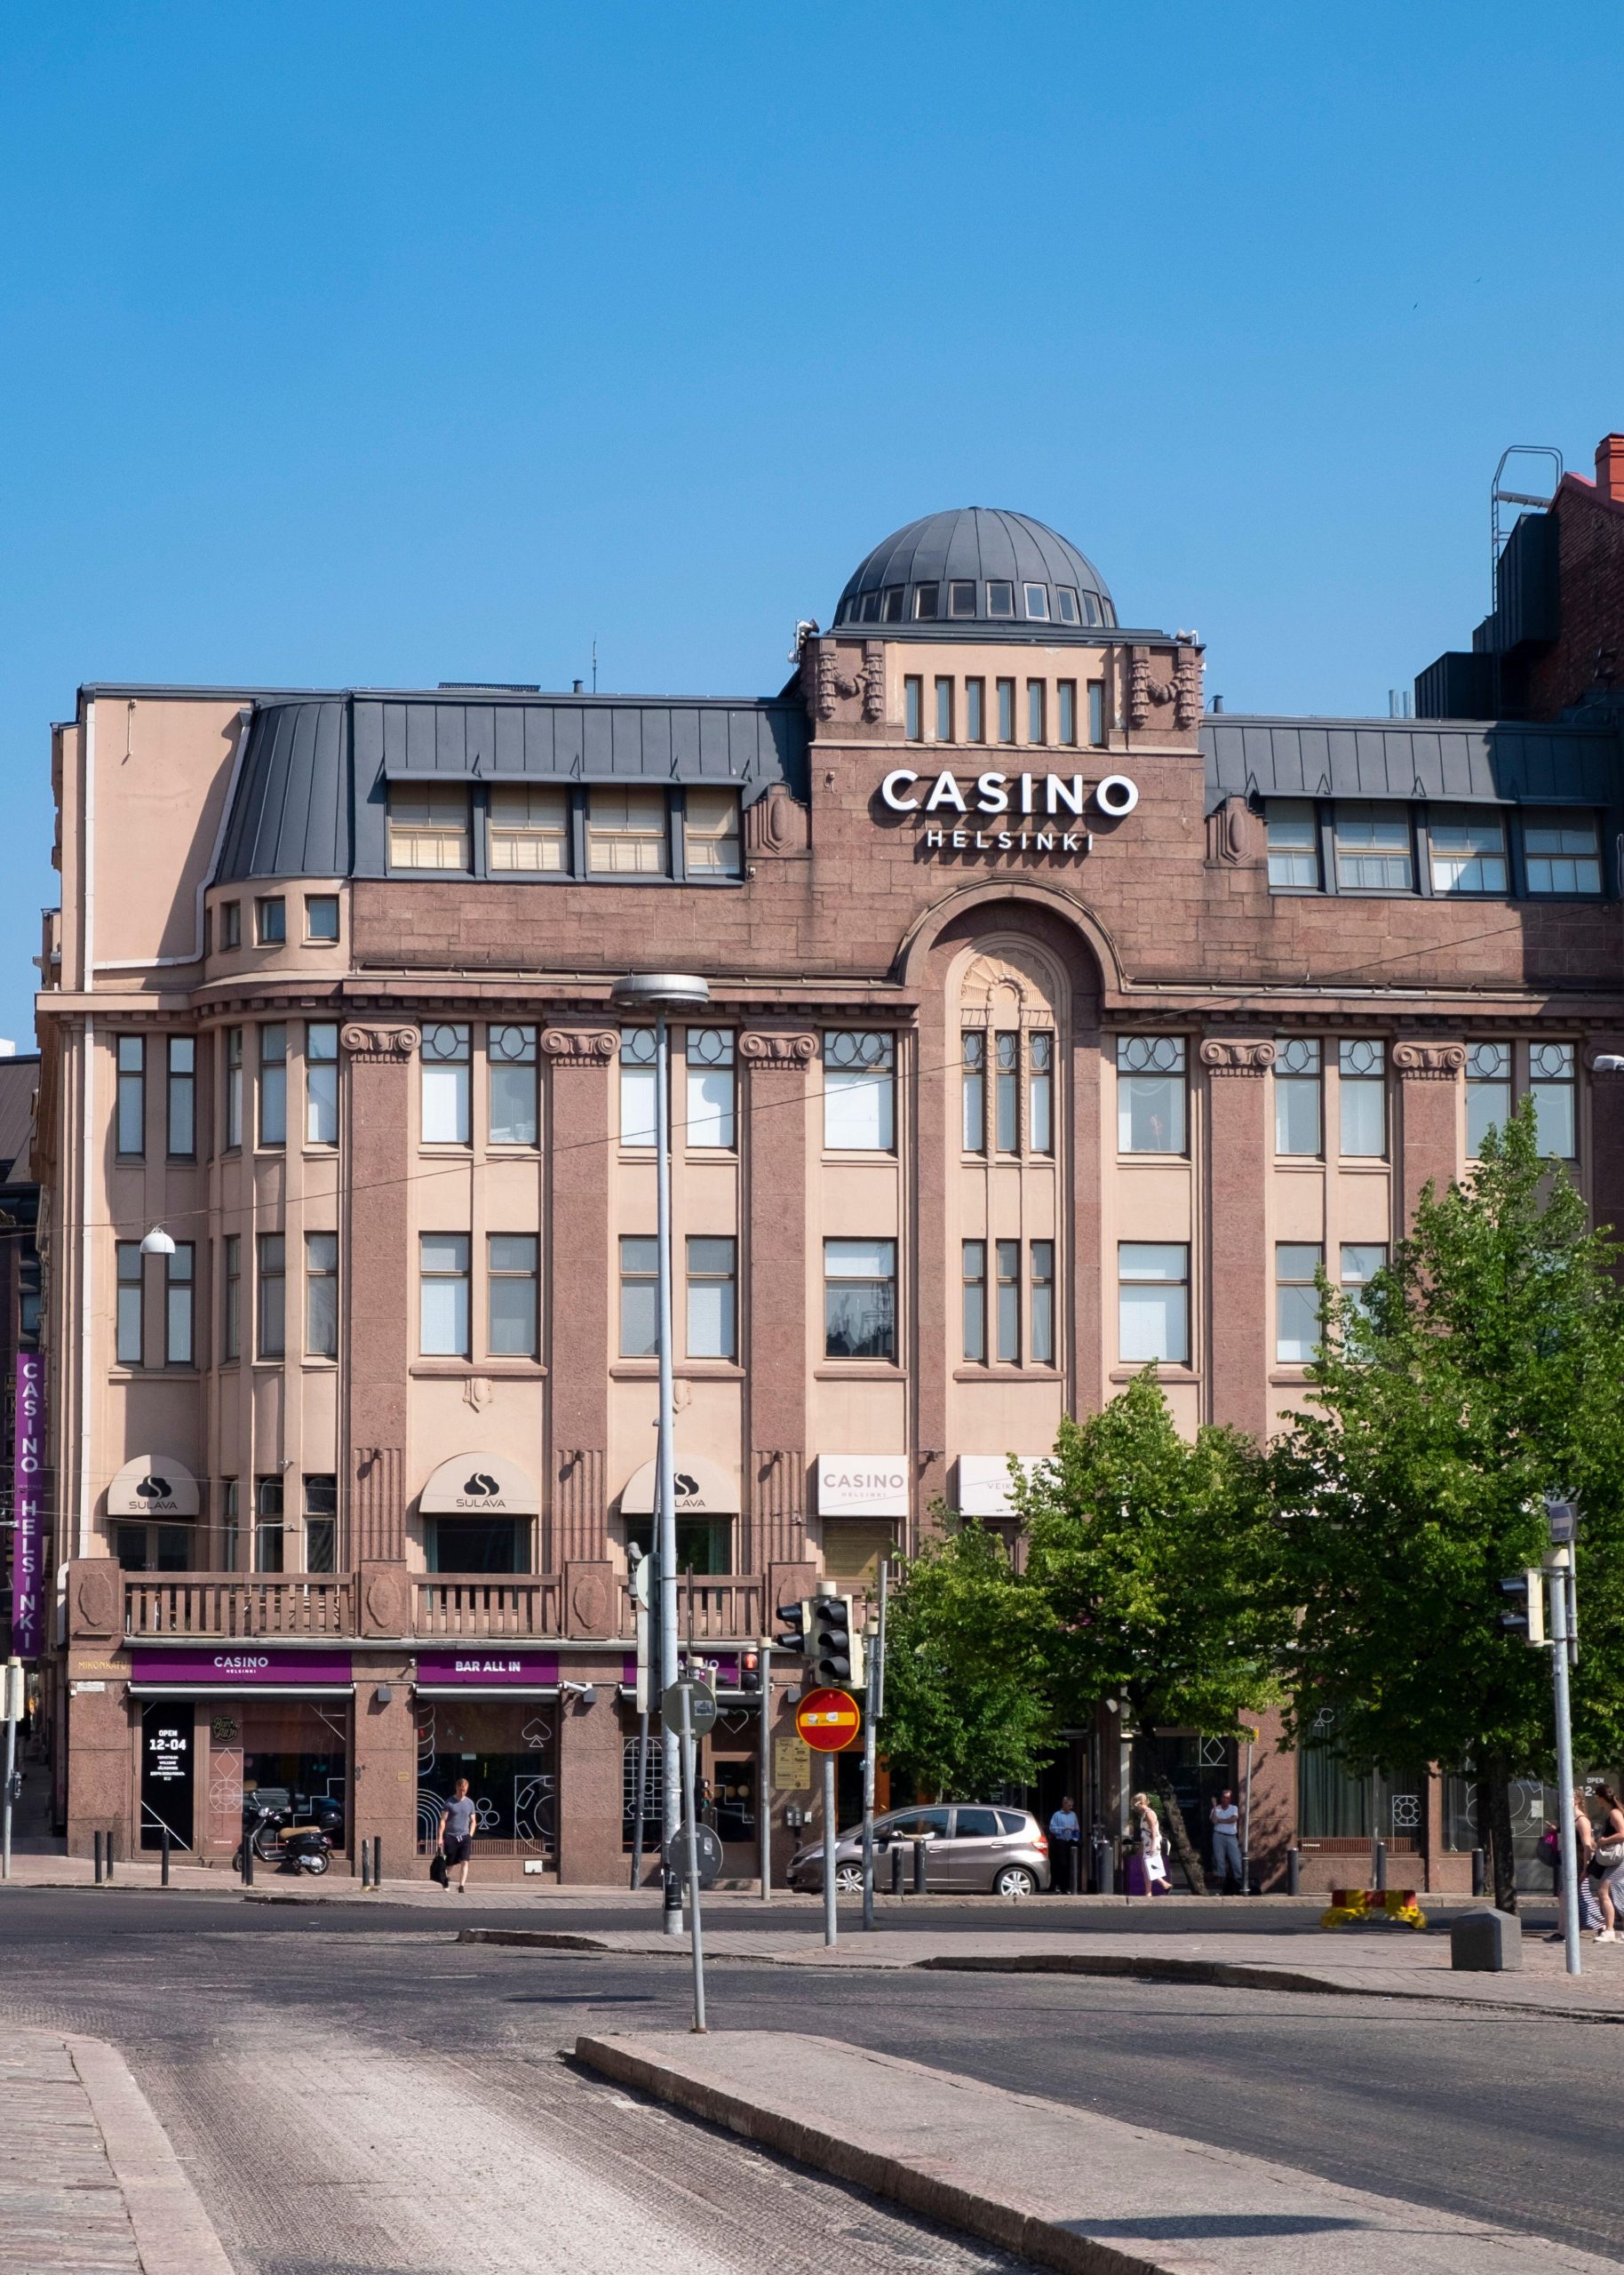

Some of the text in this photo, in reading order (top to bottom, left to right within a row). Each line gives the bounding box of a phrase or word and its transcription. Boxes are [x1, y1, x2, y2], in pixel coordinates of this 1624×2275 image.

[881, 769, 1139, 816] CASINO
[927, 829, 1094, 851] HELSINKI
[20, 1362, 39, 1473] CASINO
[824, 1474, 904, 1489] CASINO
[129, 1501, 178, 1510] SULAVA
[456, 1498, 506, 1508] SULAVA
[674, 1498, 706, 1508] LAVA
[20, 1499, 36, 1649] HELSINKI
[213, 1656, 269, 1668] CASINO
[455, 1661, 521, 1672] BAR ALL IN
[149, 1739, 187, 1751] 12-04
